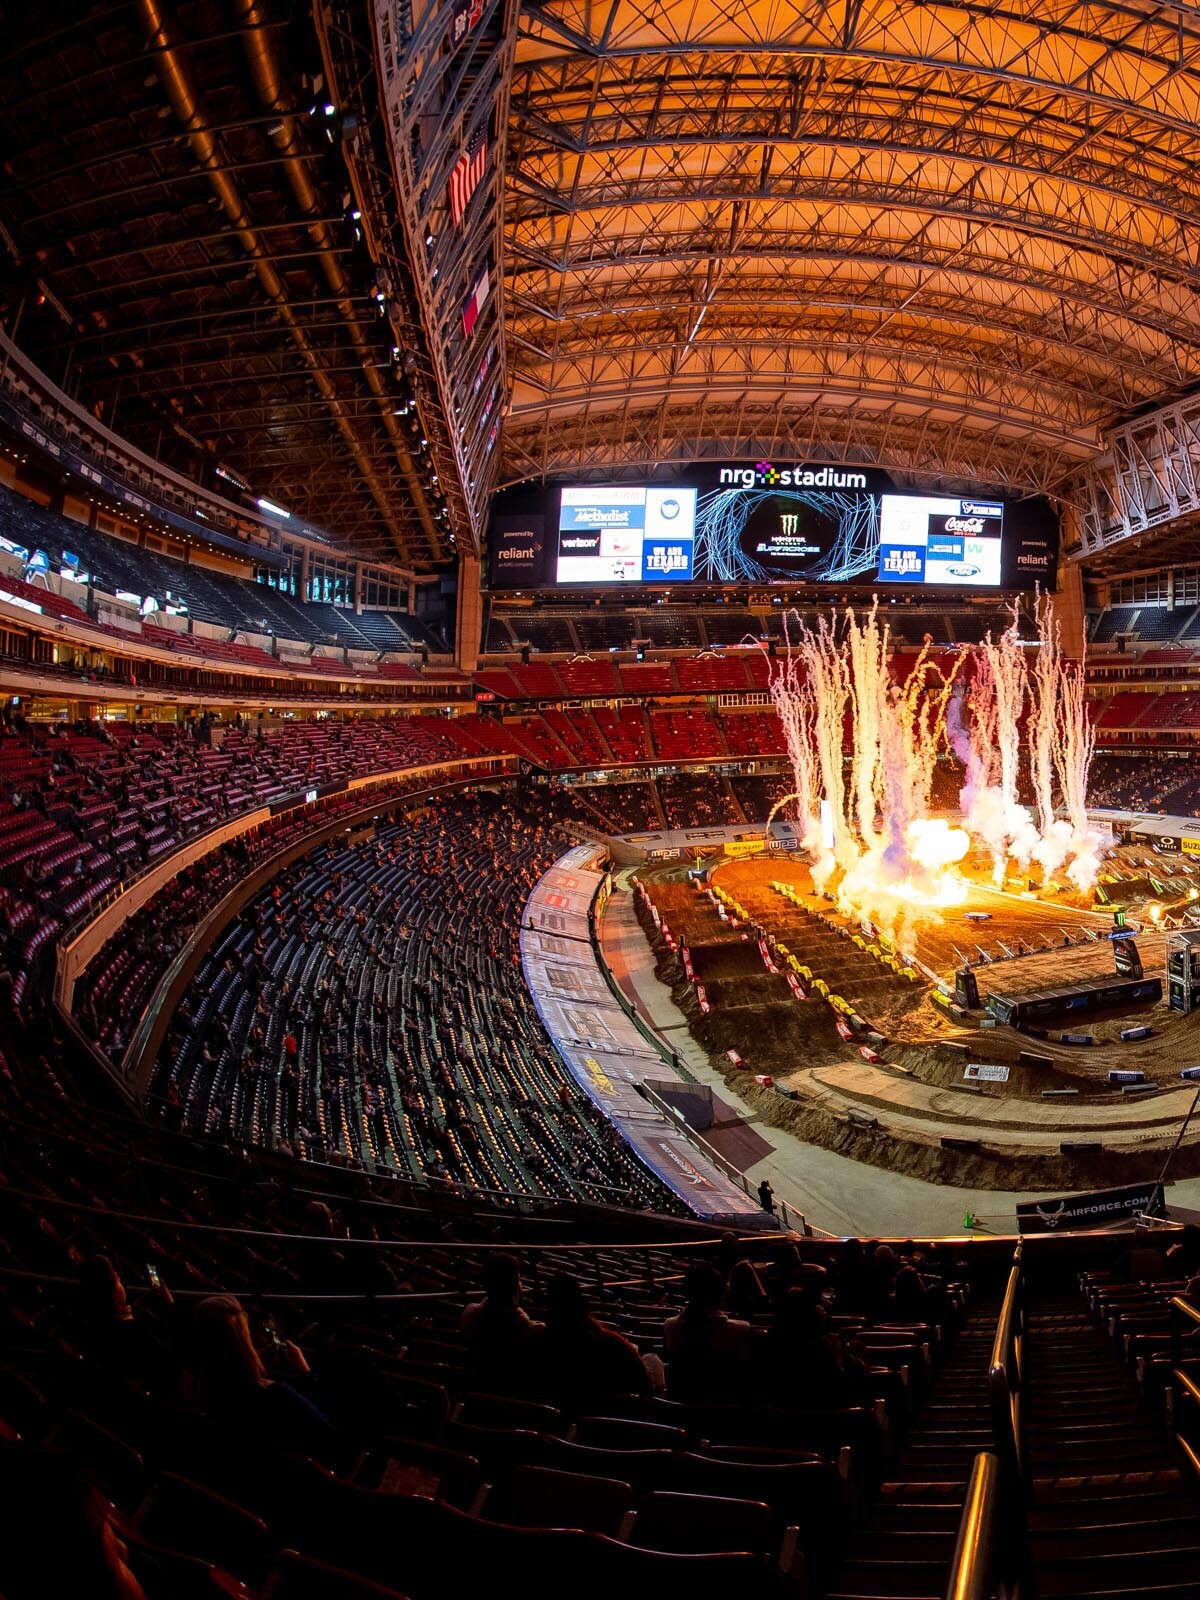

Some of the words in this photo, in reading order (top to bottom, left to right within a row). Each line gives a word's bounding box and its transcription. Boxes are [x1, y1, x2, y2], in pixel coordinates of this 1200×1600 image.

[719, 468, 756, 488] nrg
[779, 468, 867, 488] stadium
[562, 539, 596, 548] verizon
[498, 547, 535, 559] reliant
[1017, 554, 1049, 566] reliant
[769, 840, 798, 850] WPS
[1065, 1196, 1149, 1218] AIRFORCE.COM
